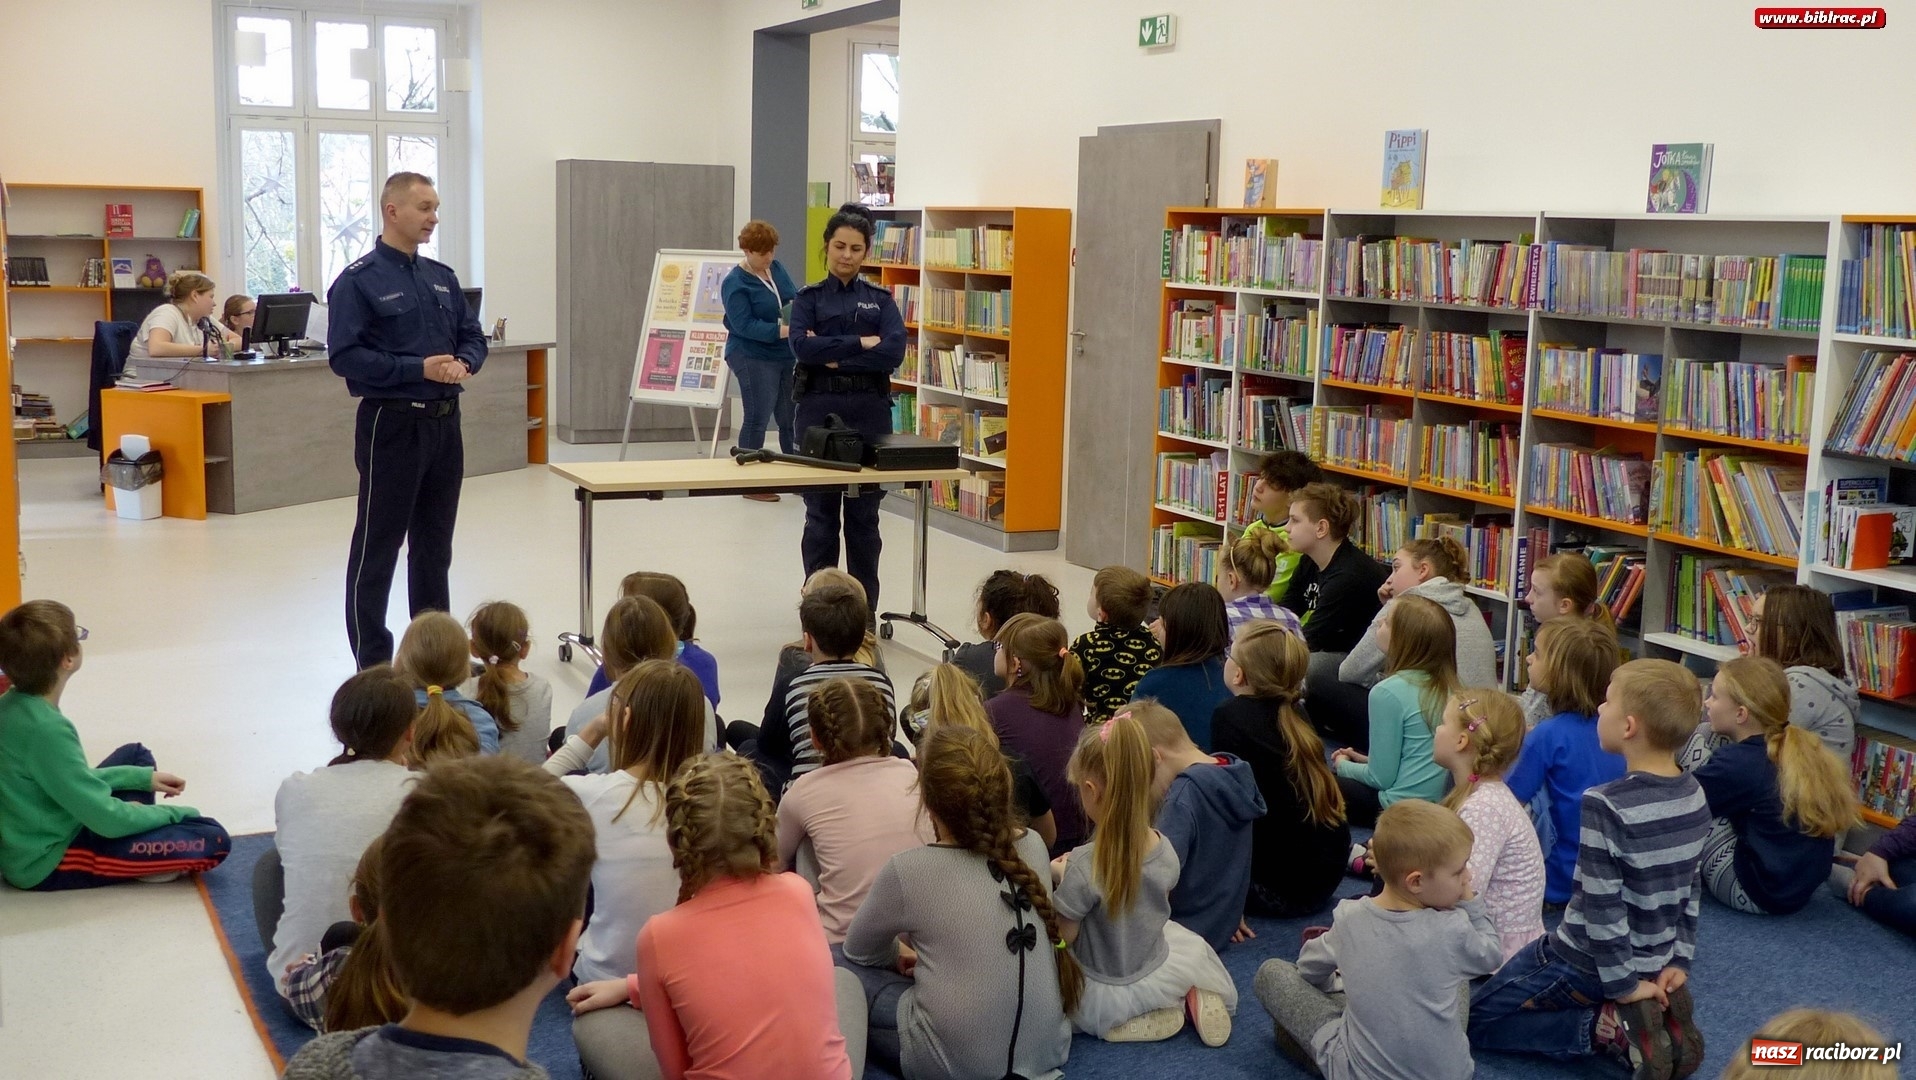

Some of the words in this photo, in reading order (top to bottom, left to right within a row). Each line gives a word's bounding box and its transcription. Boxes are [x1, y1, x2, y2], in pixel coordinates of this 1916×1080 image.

[1388, 132, 1417, 149] Pippi
[1653, 151, 1681, 168] JOTKA
[1164, 233, 1172, 252] LAT
[1163, 255, 1171, 275] 8-11
[690, 346, 706, 354] DZIECI
[1314, 411, 1322, 432] LAT
[1312, 436, 1320, 457] 8-11
[1219, 475, 1227, 494] LAT
[1218, 497, 1226, 518] 8-11
[1810, 504, 1818, 551] KOMIKSY
[1517, 547, 1527, 589] BAŚNIE
[129, 838, 205, 856] predator
